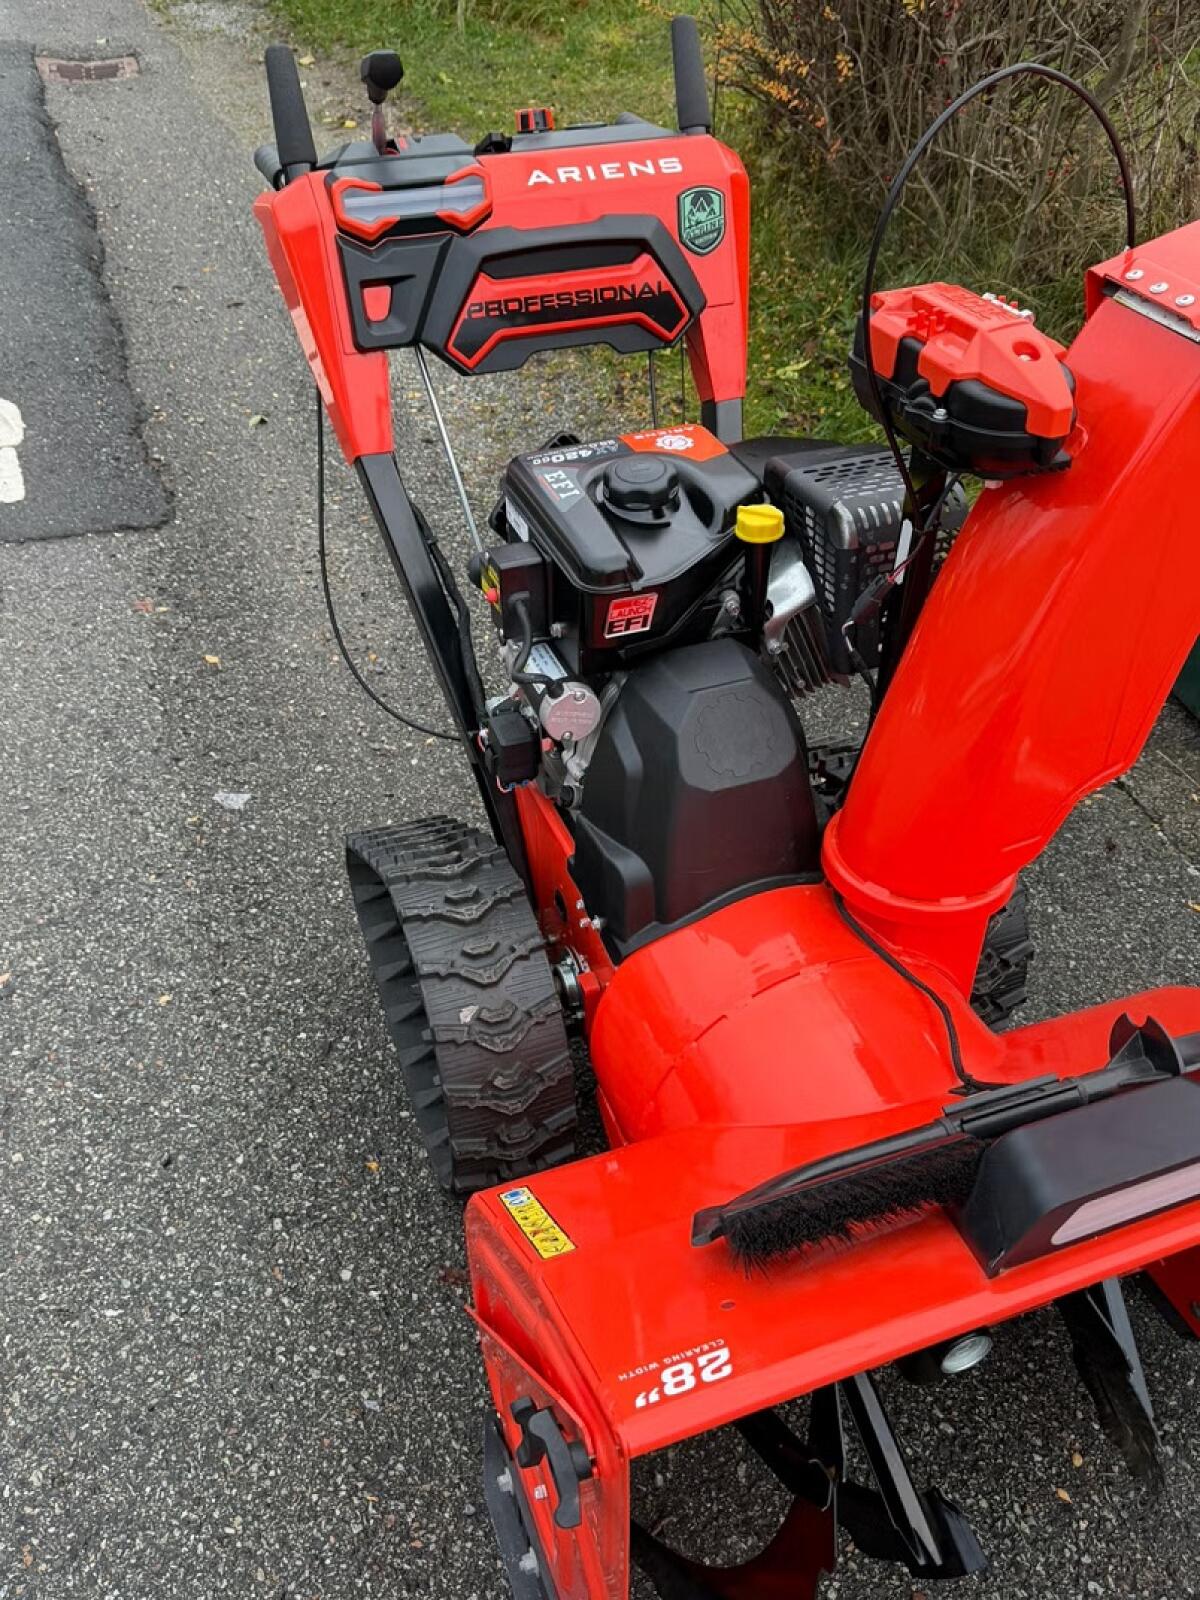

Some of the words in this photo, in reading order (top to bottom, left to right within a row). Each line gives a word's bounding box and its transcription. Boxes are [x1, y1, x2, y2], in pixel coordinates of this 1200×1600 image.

[527, 157, 683, 186] ARIENS
[467, 281, 670, 319] PROFESSIONAL
[543, 470, 581, 499] EFI
[607, 614, 650, 636] EFI
[663, 1338, 725, 1365] CLEARING
[618, 1361, 660, 1382] WIDTH
